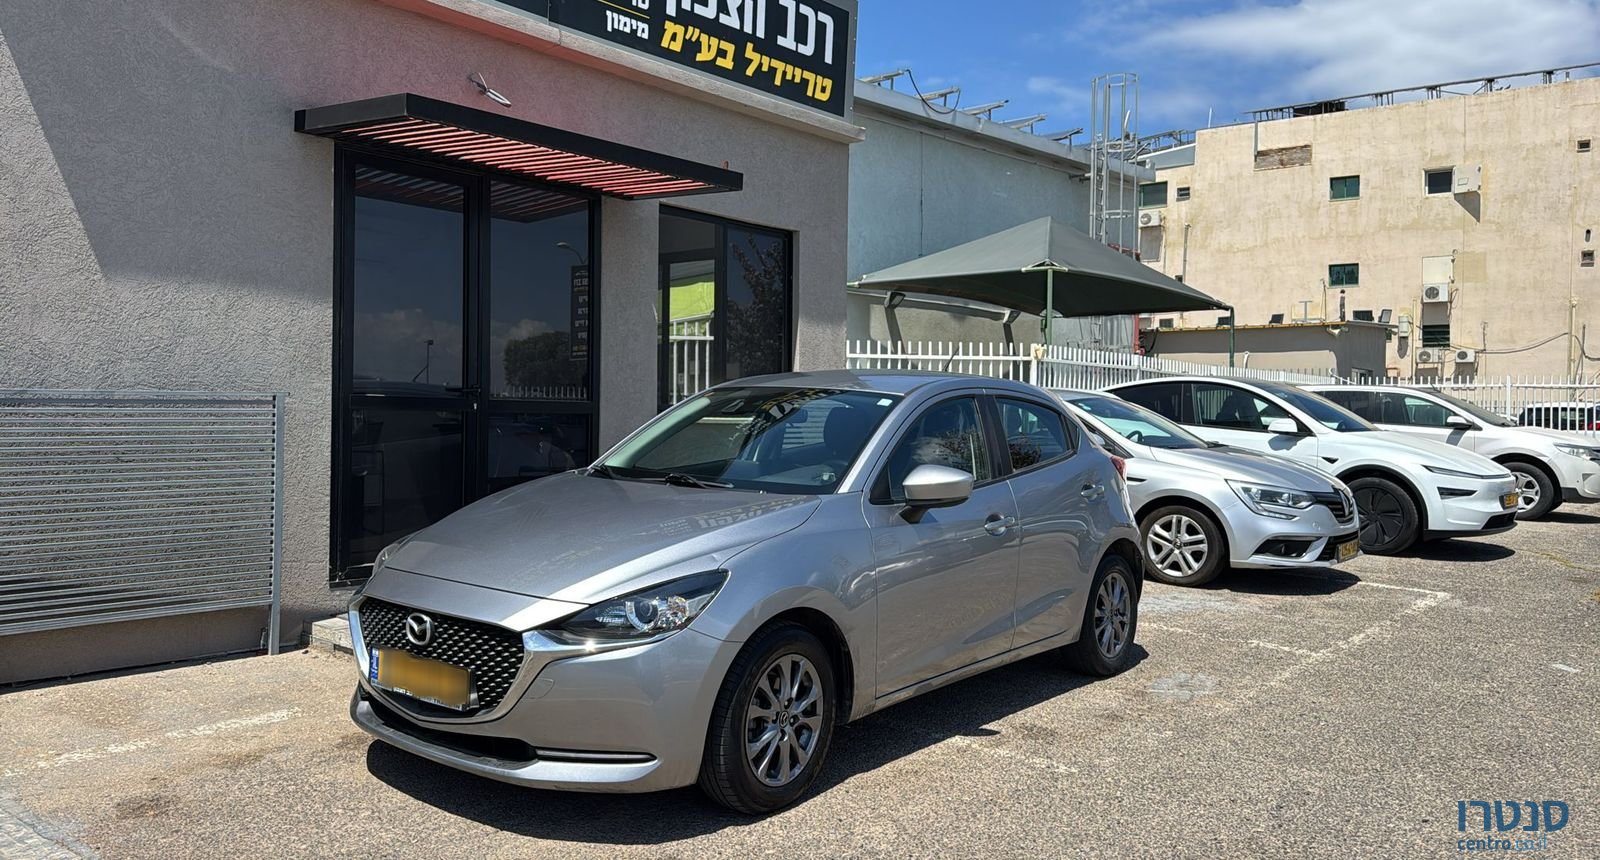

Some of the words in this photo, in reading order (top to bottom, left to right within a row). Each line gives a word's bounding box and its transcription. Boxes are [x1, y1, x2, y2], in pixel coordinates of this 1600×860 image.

[605, 9, 649, 40] מימון
[776, 0, 834, 65] רכב
[744, 41, 833, 102] טריידיל
